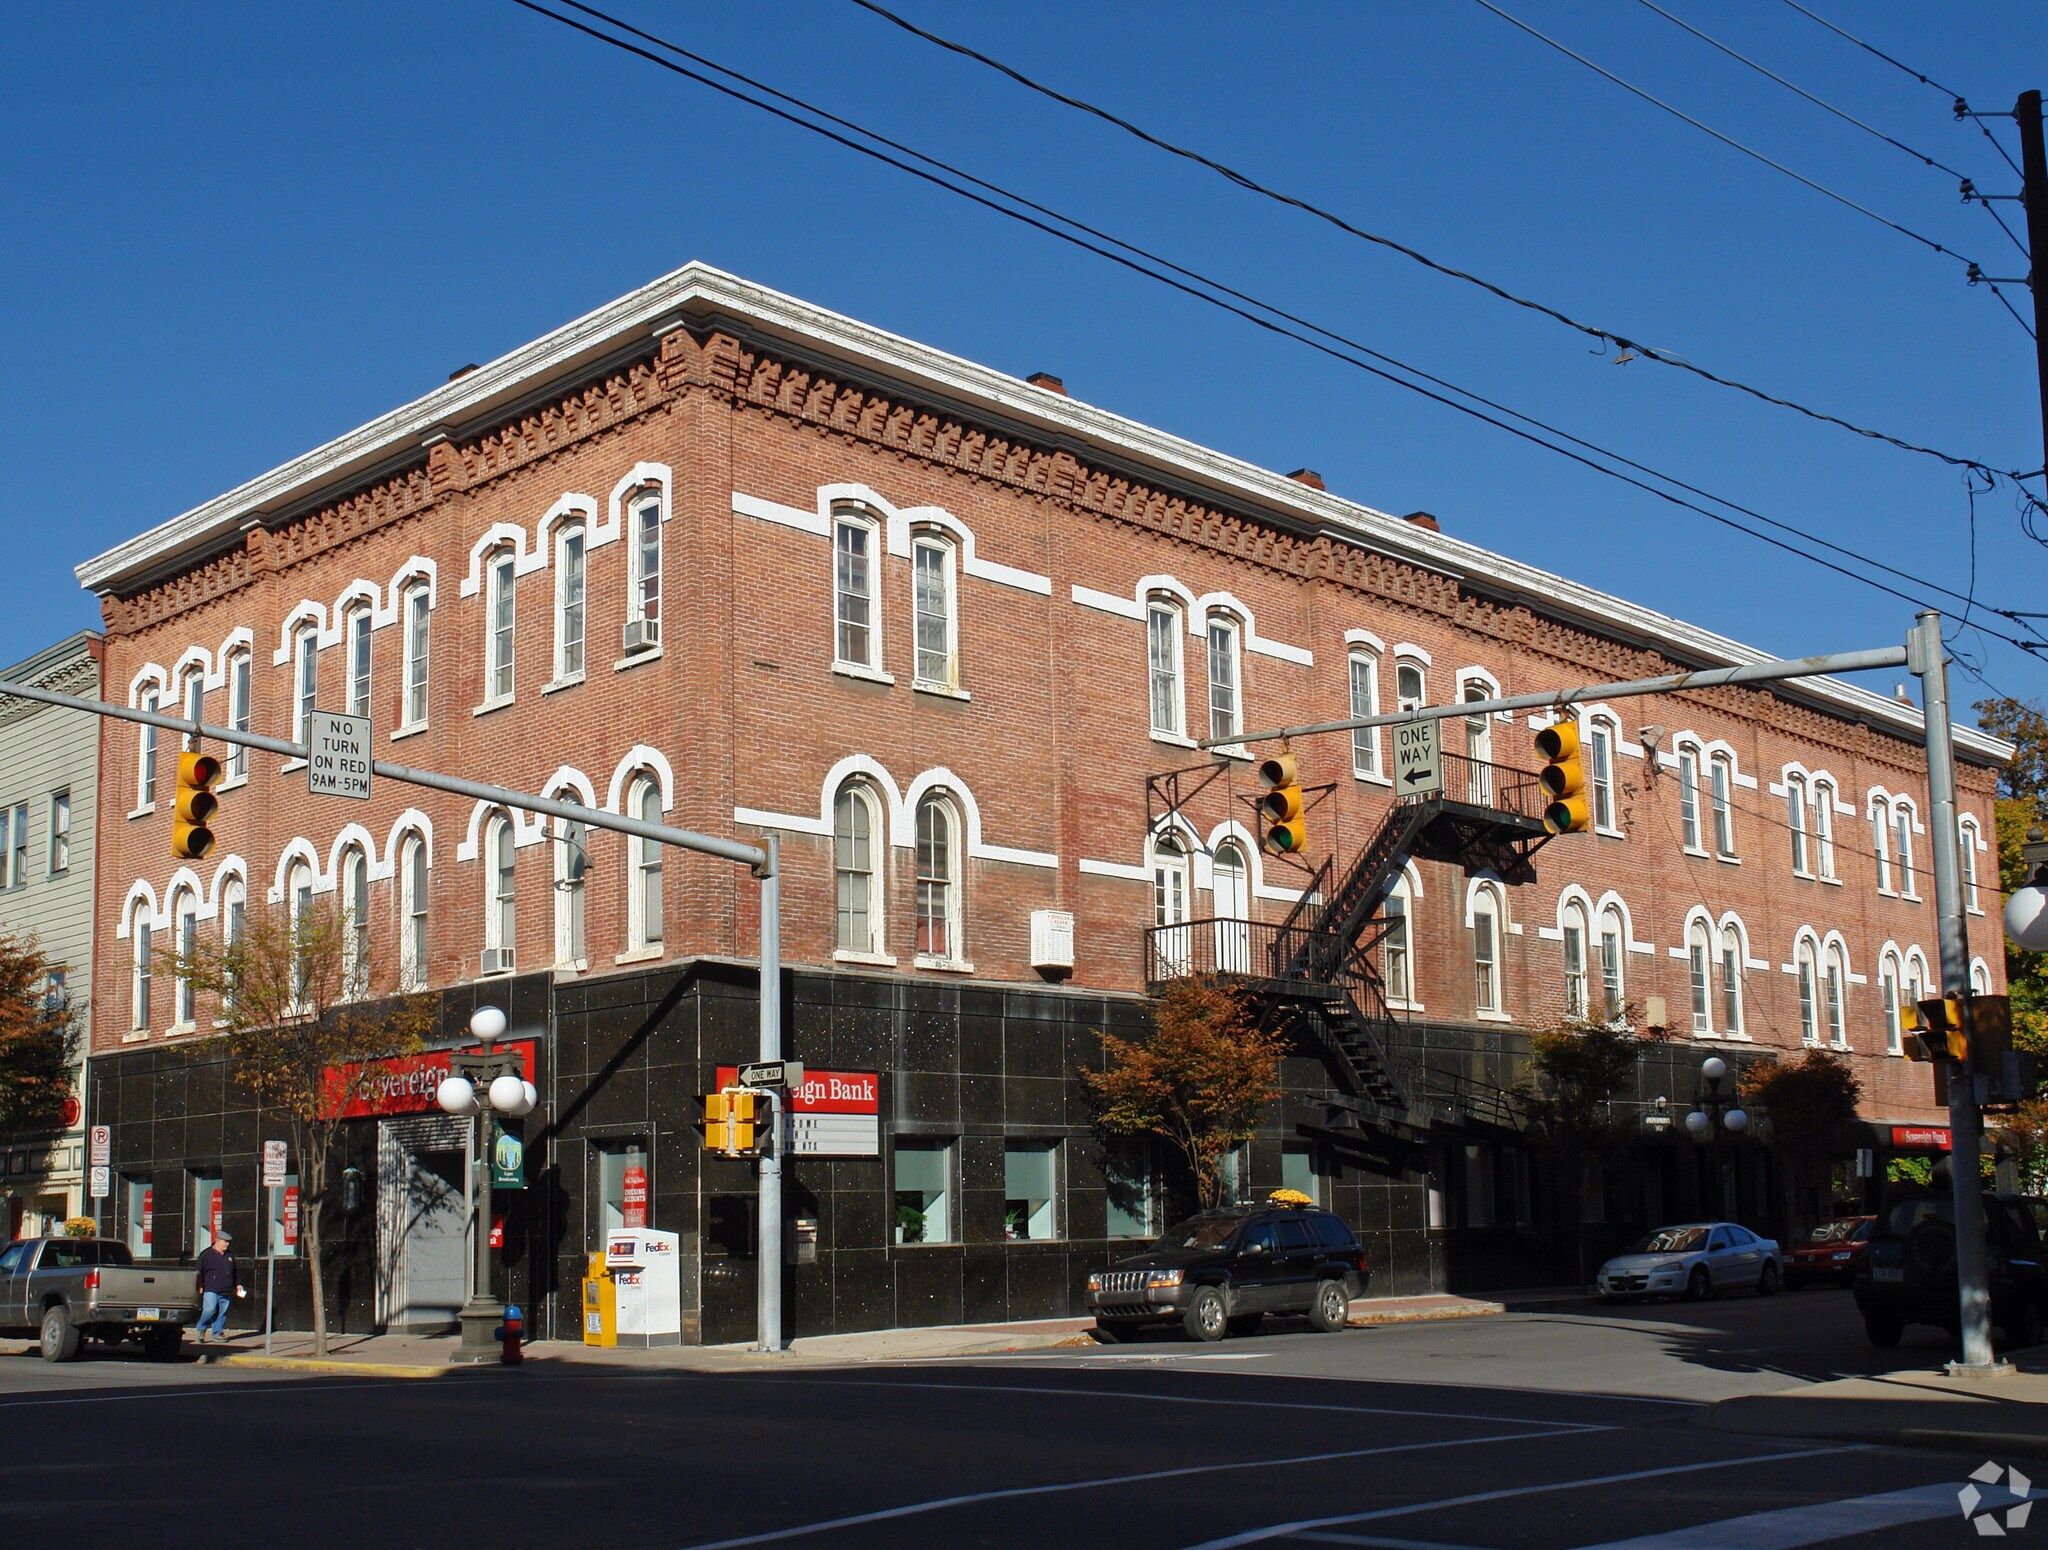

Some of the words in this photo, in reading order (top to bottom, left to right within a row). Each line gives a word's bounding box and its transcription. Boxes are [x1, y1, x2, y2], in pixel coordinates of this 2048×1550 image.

[331, 720, 353, 735] NO
[1401, 725, 1430, 746] ONE
[323, 737, 359, 755] TURN
[1400, 744, 1432, 765] WAY
[315, 755, 333, 770] ON
[340, 759, 366, 774] RED
[312, 773, 368, 793] 9AM-5PM
[751, 1069, 765, 1081] ONE
[766, 1069, 781, 1079] WAY
[829, 1079, 875, 1101] Bank
[1905, 1130, 1931, 1144] Sovereign
[1932, 1131, 1947, 1144] Bank
[645, 1241, 670, 1253] FedEx
[619, 1273, 640, 1285] FedEx
